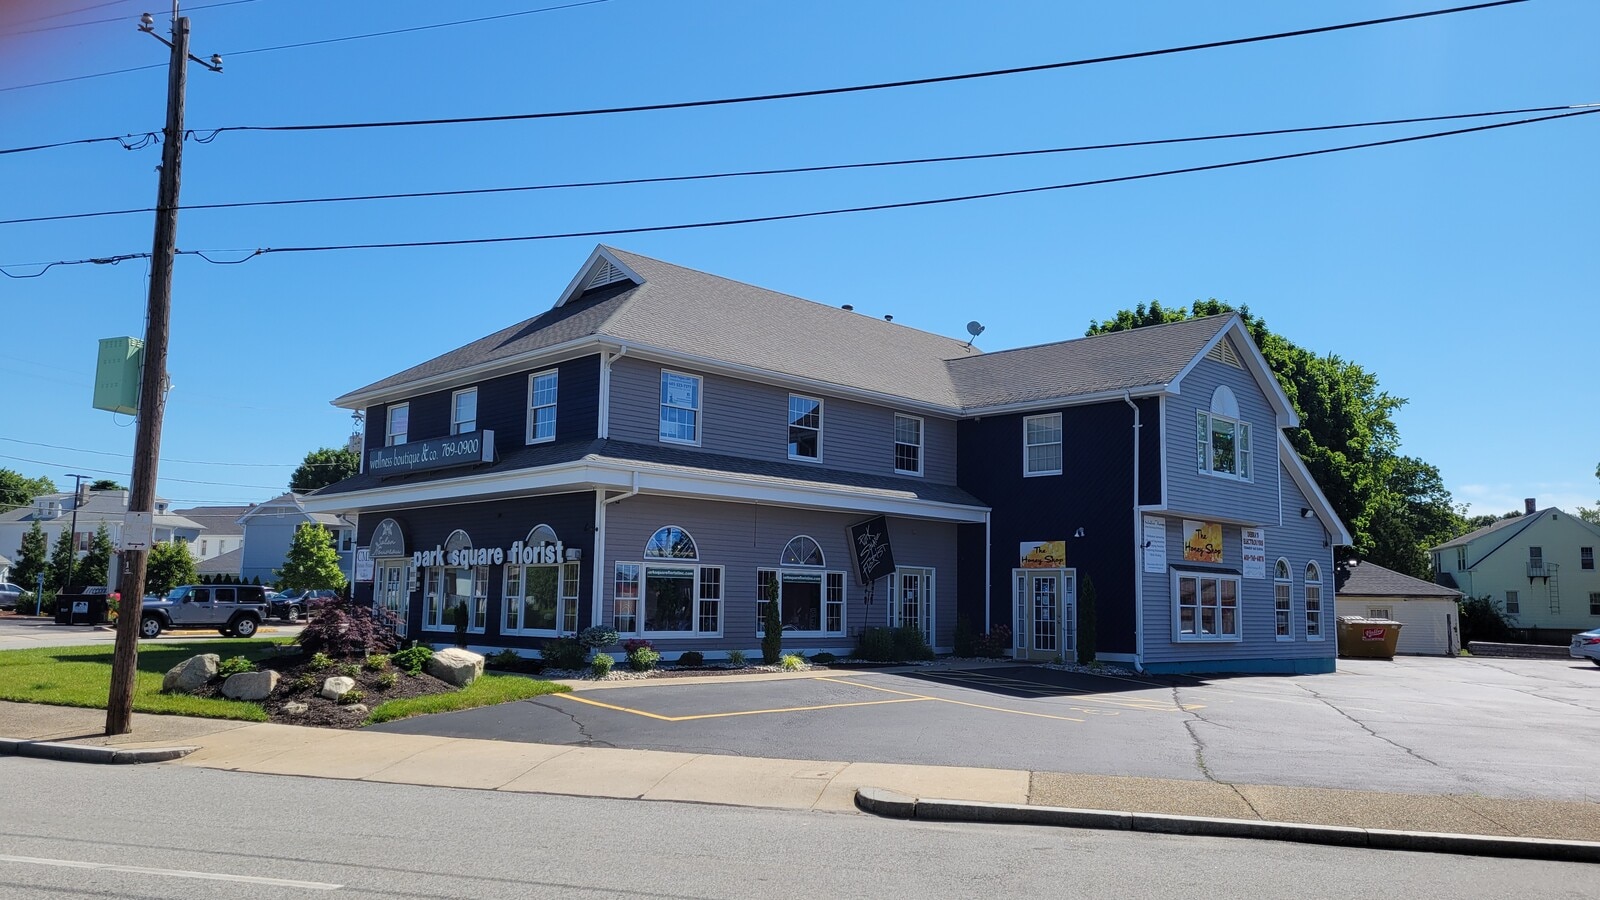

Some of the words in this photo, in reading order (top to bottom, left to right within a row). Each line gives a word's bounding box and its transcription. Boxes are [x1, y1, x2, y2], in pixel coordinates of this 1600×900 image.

[369, 450, 393, 469] wellness
[393, 448, 420, 469] boutique
[421, 443, 430, 462] &
[429, 449, 439, 461] co.
[442, 438, 479, 457] 769-0900
[1195, 529, 1208, 540] The
[413, 545, 445, 569] park
[451, 546, 504, 570] square
[511, 540, 564, 564] florist
[1033, 546, 1047, 554] The
[1185, 541, 1206, 557] Honey
[1205, 543, 1221, 556] Shop
[1021, 555, 1043, 565] Honey
[1044, 555, 1064, 565] Shop
